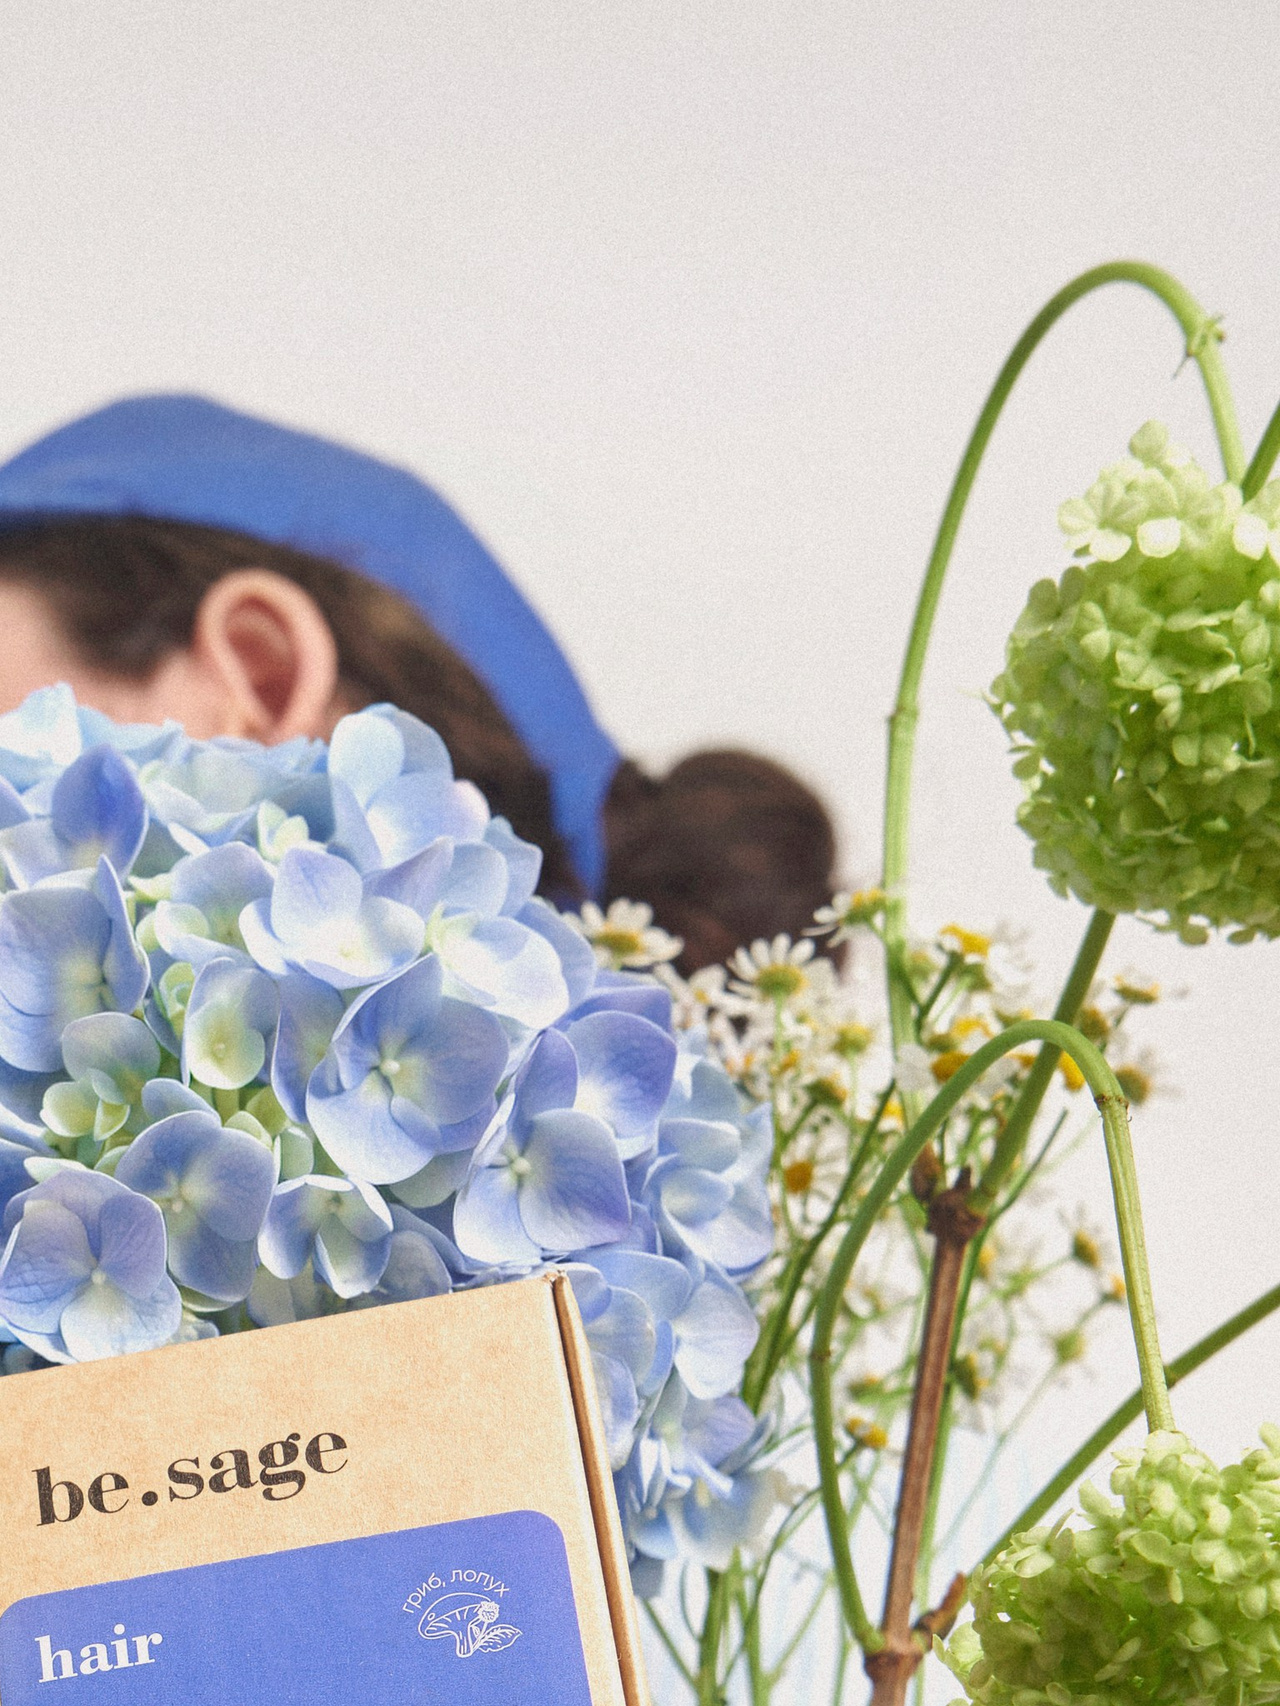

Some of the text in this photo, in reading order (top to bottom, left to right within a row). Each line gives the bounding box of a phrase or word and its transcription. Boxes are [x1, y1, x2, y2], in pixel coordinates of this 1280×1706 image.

[31, 1432, 349, 1527] be.sage
[402, 1569, 510, 1614] гриб, лопух
[35, 1623, 163, 1684] hair
